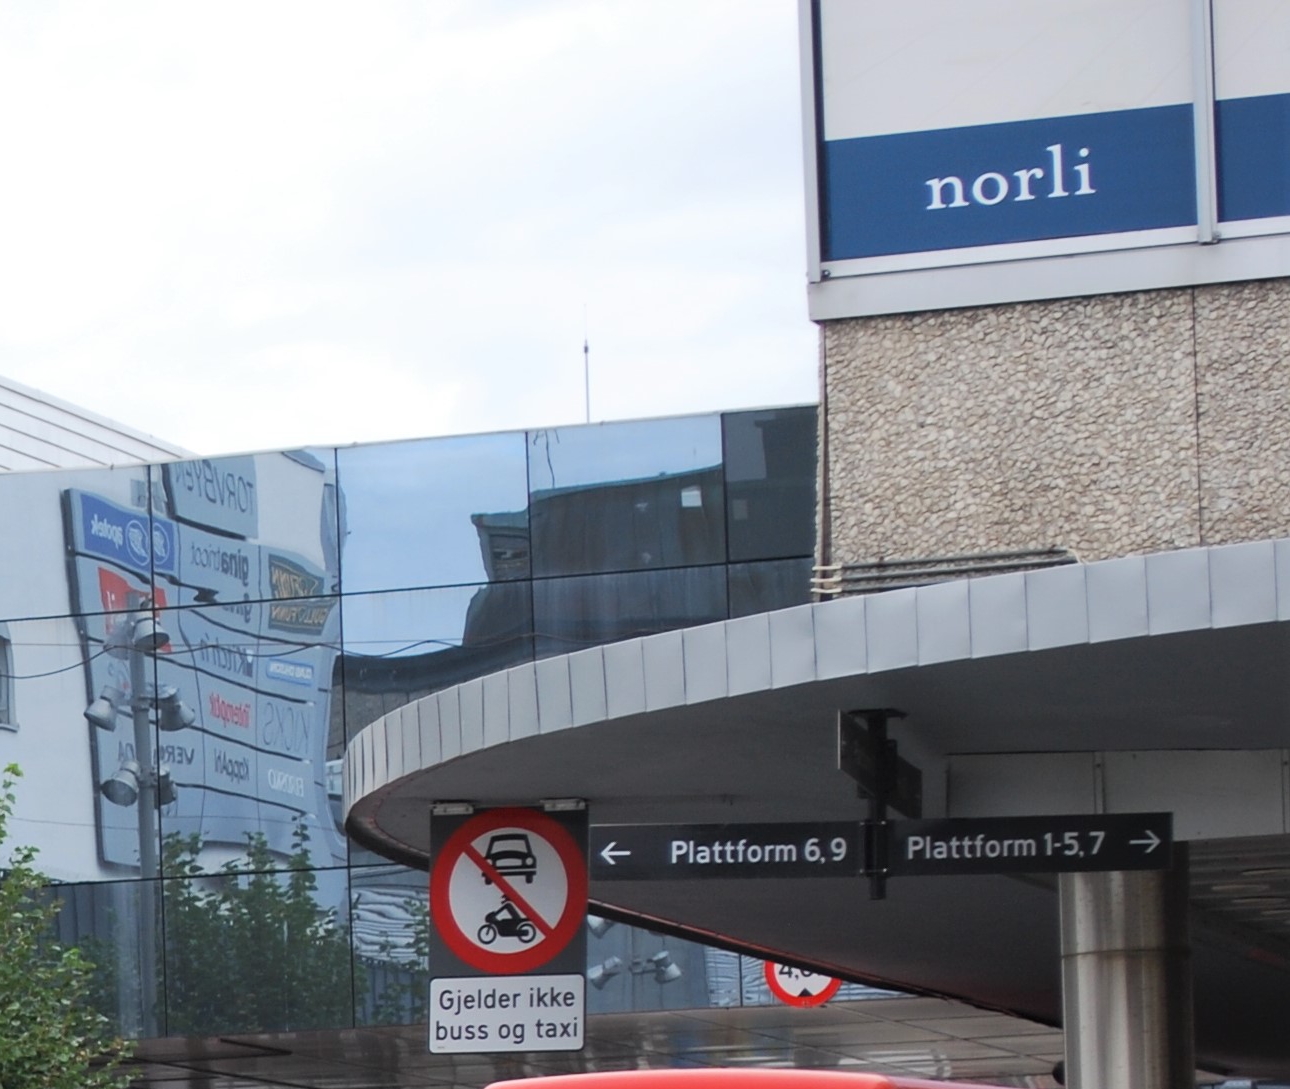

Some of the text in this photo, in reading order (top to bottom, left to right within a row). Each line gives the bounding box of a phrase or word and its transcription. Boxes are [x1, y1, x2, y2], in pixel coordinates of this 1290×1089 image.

[925, 143, 1097, 210] norli
[671, 839, 797, 863] Plattform
[908, 834, 1037, 859] Plattform
[439, 986, 575, 1015] Gjelder ikke
[435, 1017, 578, 1044] buss og taxi
